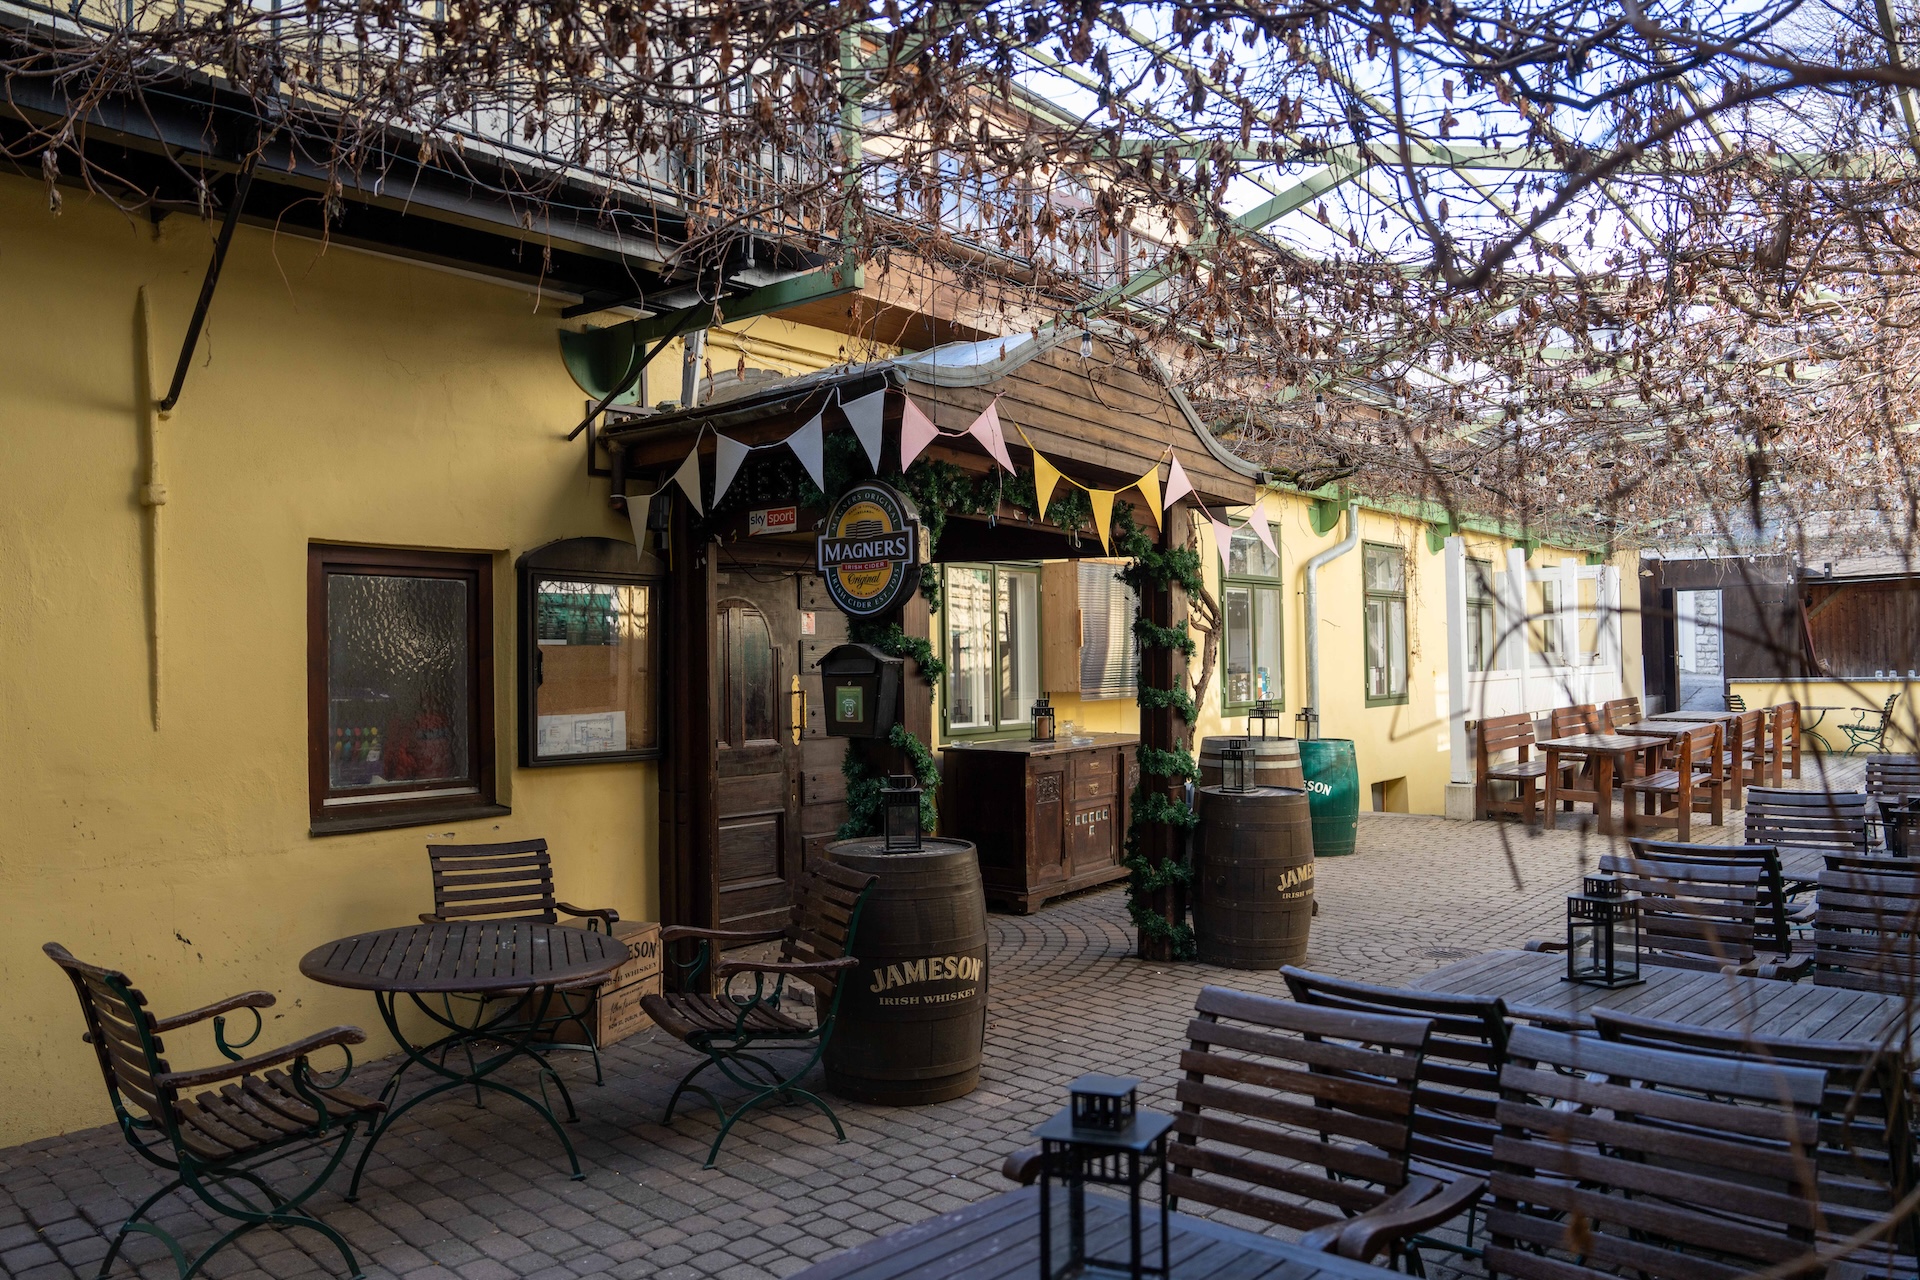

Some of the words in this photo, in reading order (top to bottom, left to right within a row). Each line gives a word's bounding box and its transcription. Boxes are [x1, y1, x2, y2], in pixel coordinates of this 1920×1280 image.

[751, 514, 766, 526] sky
[768, 510, 794, 525] sport
[831, 493, 862, 530] MAGNERS
[864, 492, 898, 525] ORIGINAL
[825, 538, 907, 562] MAGNERS
[830, 574, 847, 600] IRISH
[847, 598, 872, 608] CIDER
[847, 572, 882, 589] Original
[1277, 863, 1314, 892] JAME
[1282, 891, 1305, 899] IRISH
[624, 961, 657, 979] WHISKEY
[870, 956, 981, 993] JAMESON
[879, 996, 920, 1006] IRISH
[923, 987, 977, 1004] WHISKEY
